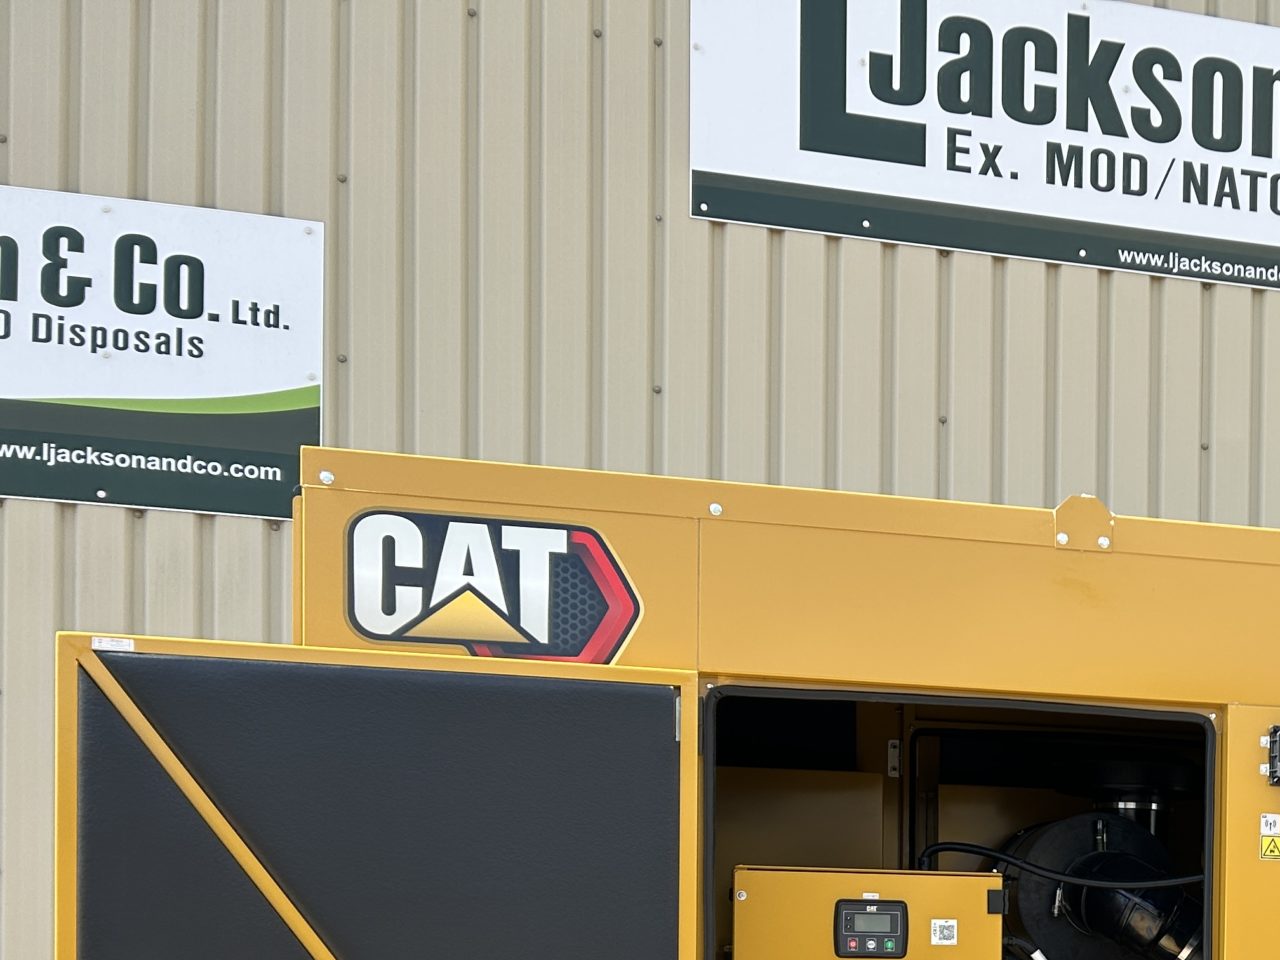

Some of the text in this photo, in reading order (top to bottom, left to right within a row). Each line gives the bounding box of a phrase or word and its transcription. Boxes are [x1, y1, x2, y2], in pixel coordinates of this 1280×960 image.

[946, 127, 1019, 180] Ex.
[40, 226, 92, 308] &
[114, 234, 220, 322] Co.
[231, 299, 290, 330] Ltd.
[31, 312, 204, 358] Disposals
[353, 513, 568, 644] CAT
